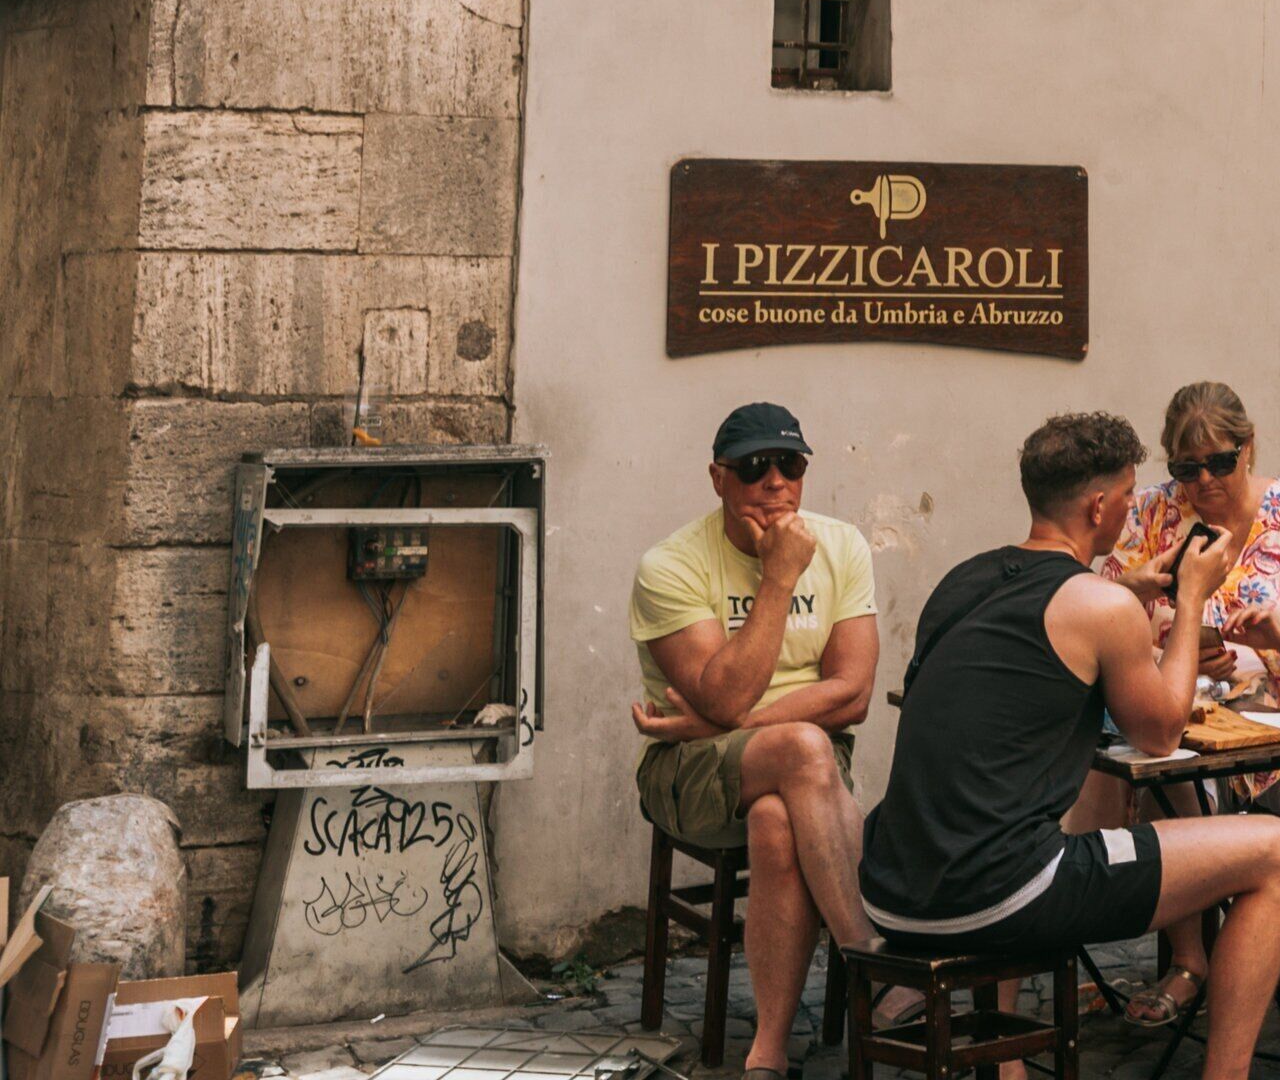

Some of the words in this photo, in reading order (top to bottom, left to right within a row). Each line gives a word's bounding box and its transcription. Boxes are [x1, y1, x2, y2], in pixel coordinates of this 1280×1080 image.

[701, 243, 719, 284] I
[733, 244, 1064, 288] PIZZICAROLI
[699, 306, 749, 324] cose
[754, 301, 825, 324] buone
[831, 302, 857, 324] da
[864, 302, 948, 325] Umbria
[953, 309, 965, 325] e
[971, 302, 1063, 325] Abruzzo
[728, 595, 815, 614] TOMY
